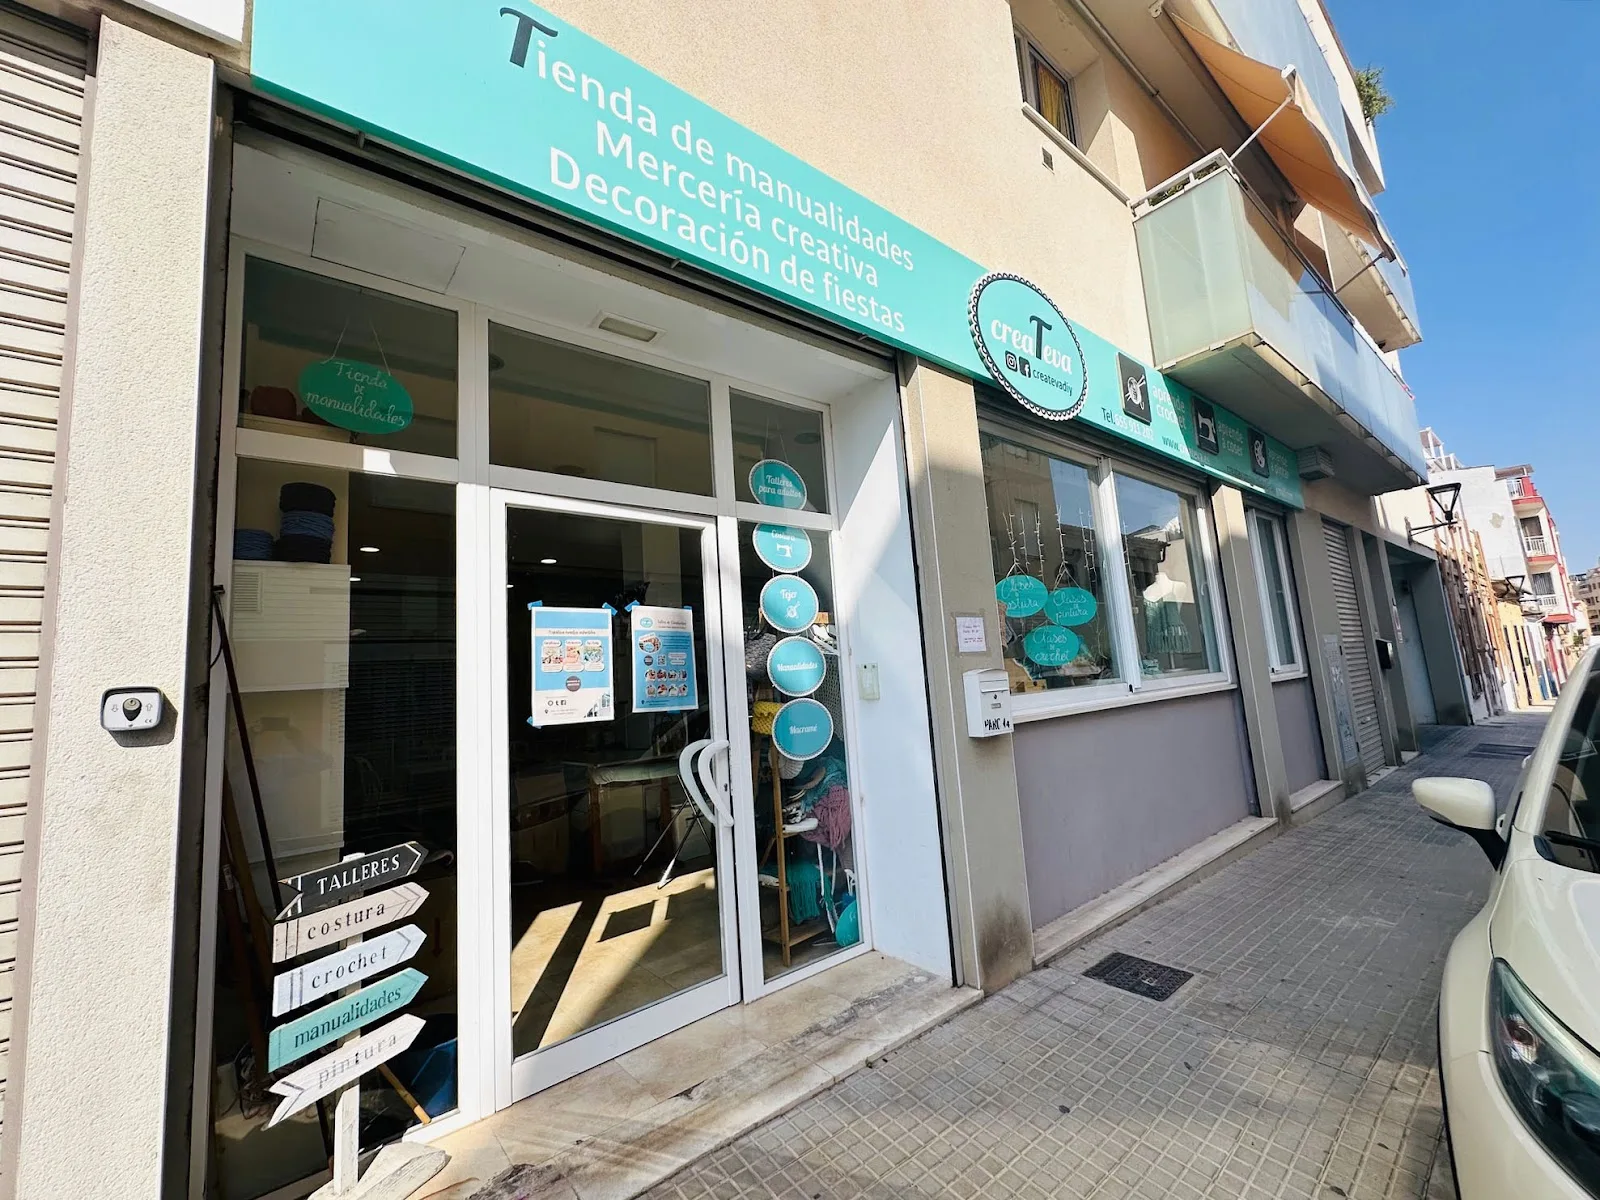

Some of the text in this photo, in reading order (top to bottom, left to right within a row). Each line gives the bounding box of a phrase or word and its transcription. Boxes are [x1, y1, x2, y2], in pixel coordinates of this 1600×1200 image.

[499, 6, 914, 272] Tienda de manualidades
[596, 120, 878, 288] Mercería creativa
[549, 146, 905, 332] Decoración de fiestas
[990, 315, 1073, 375] creaTeva
[335, 361, 388, 389] Tienda
[1032, 369, 1073, 397] createvadiy
[306, 391, 405, 427] manualidades
[758, 485, 776, 495] para
[765, 474, 793, 488] Talleres
[1007, 599, 1039, 610] ostura
[316, 853, 401, 896] TALLERES
[307, 901, 386, 940] costura
[311, 943, 388, 989] crochet
[294, 986, 402, 1049] manualidades
[317, 1033, 397, 1090] pintura
